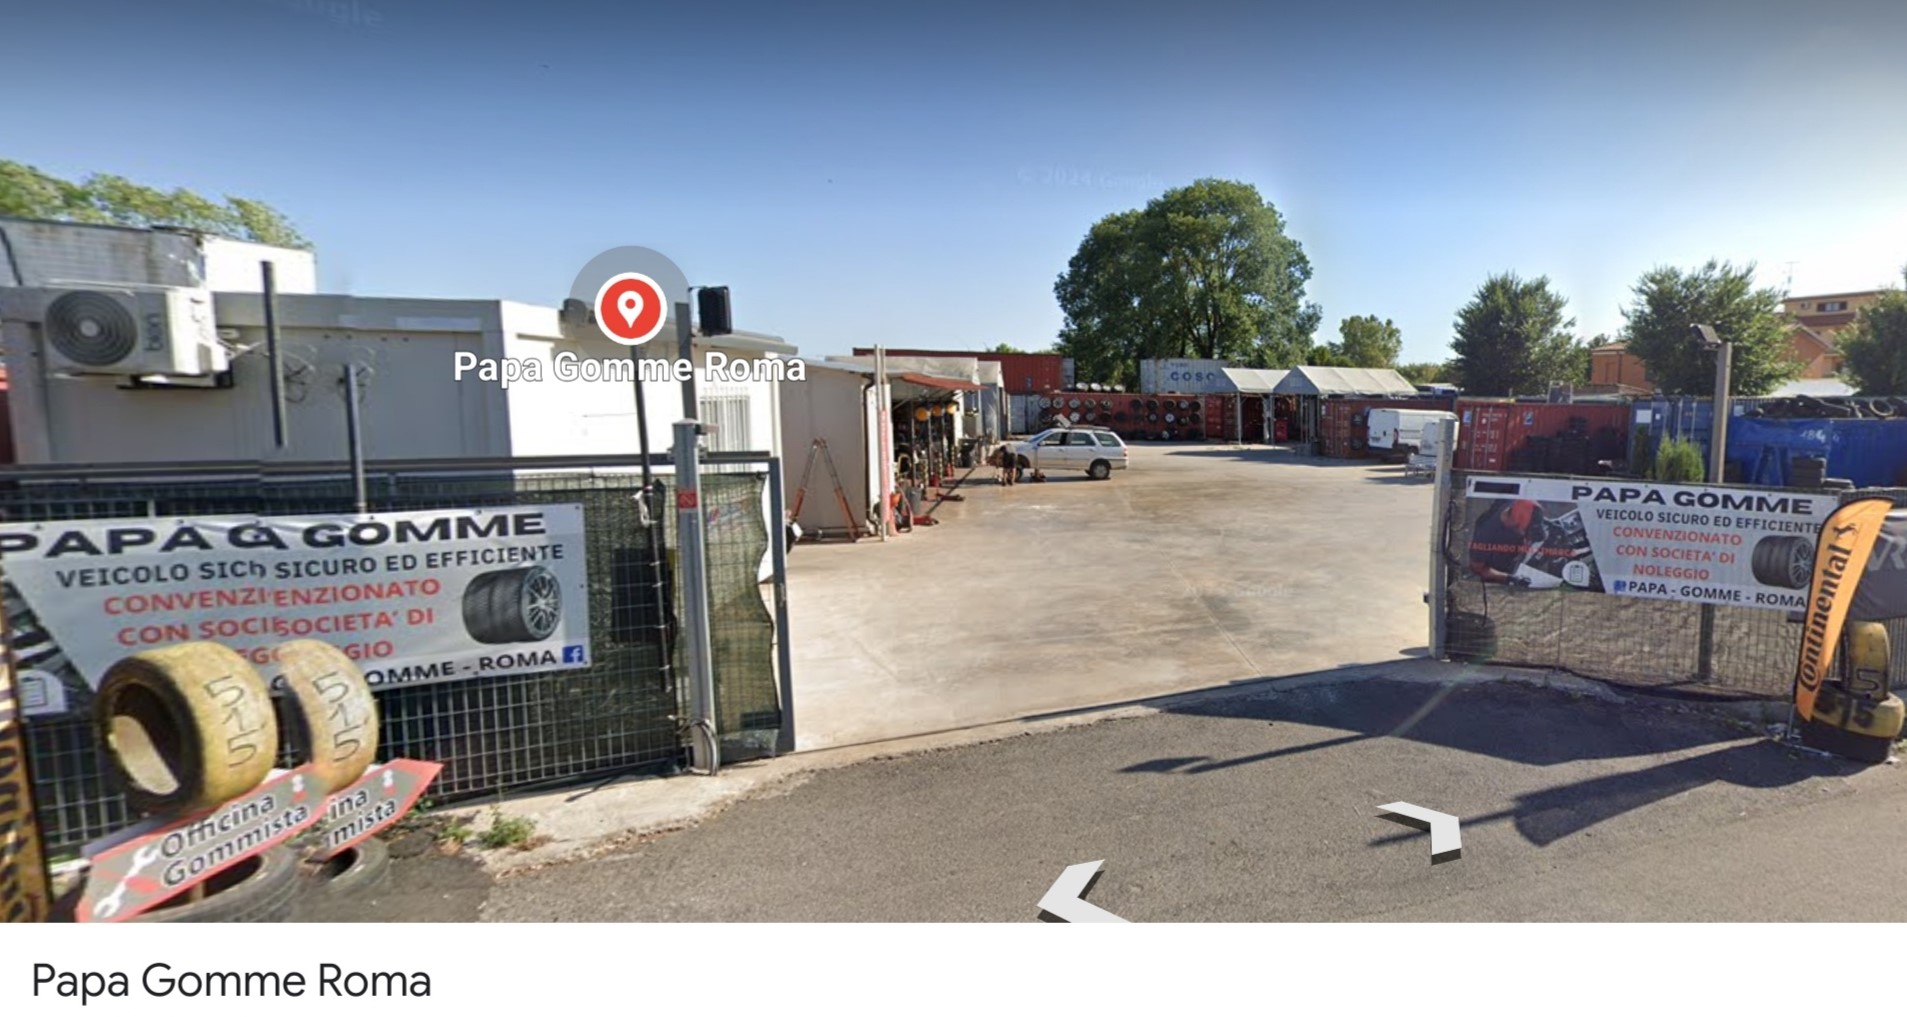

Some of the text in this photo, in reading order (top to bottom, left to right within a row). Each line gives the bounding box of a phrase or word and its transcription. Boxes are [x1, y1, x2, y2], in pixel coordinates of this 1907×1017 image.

[1571, 485, 1814, 516] PAPA GOMME
[302, 512, 547, 549] GOMME
[1596, 508, 1821, 535] VEICOLO SICURO ED EFFICIENTE
[1612, 525, 1743, 546] CONVENZIONATO
[55, 563, 190, 589] VEICOLO
[275, 556, 378, 580] SICURO
[386, 553, 419, 572] ED
[426, 543, 565, 569] EFFICIENTE
[1615, 543, 1736, 564] CON SOCIETA' DI
[1632, 563, 1710, 581] NOLEGGIO
[1628, 581, 1668, 596] PAPA
[1680, 585, 1742, 602] GOMME
[1755, 592, 1808, 609] ROMA
[116, 624, 190, 646] CON
[406, 607, 434, 626] DI
[1800, 543, 1853, 692] Continental
[479, 649, 557, 672] ROMA
[162, 804, 309, 886] Gommista
